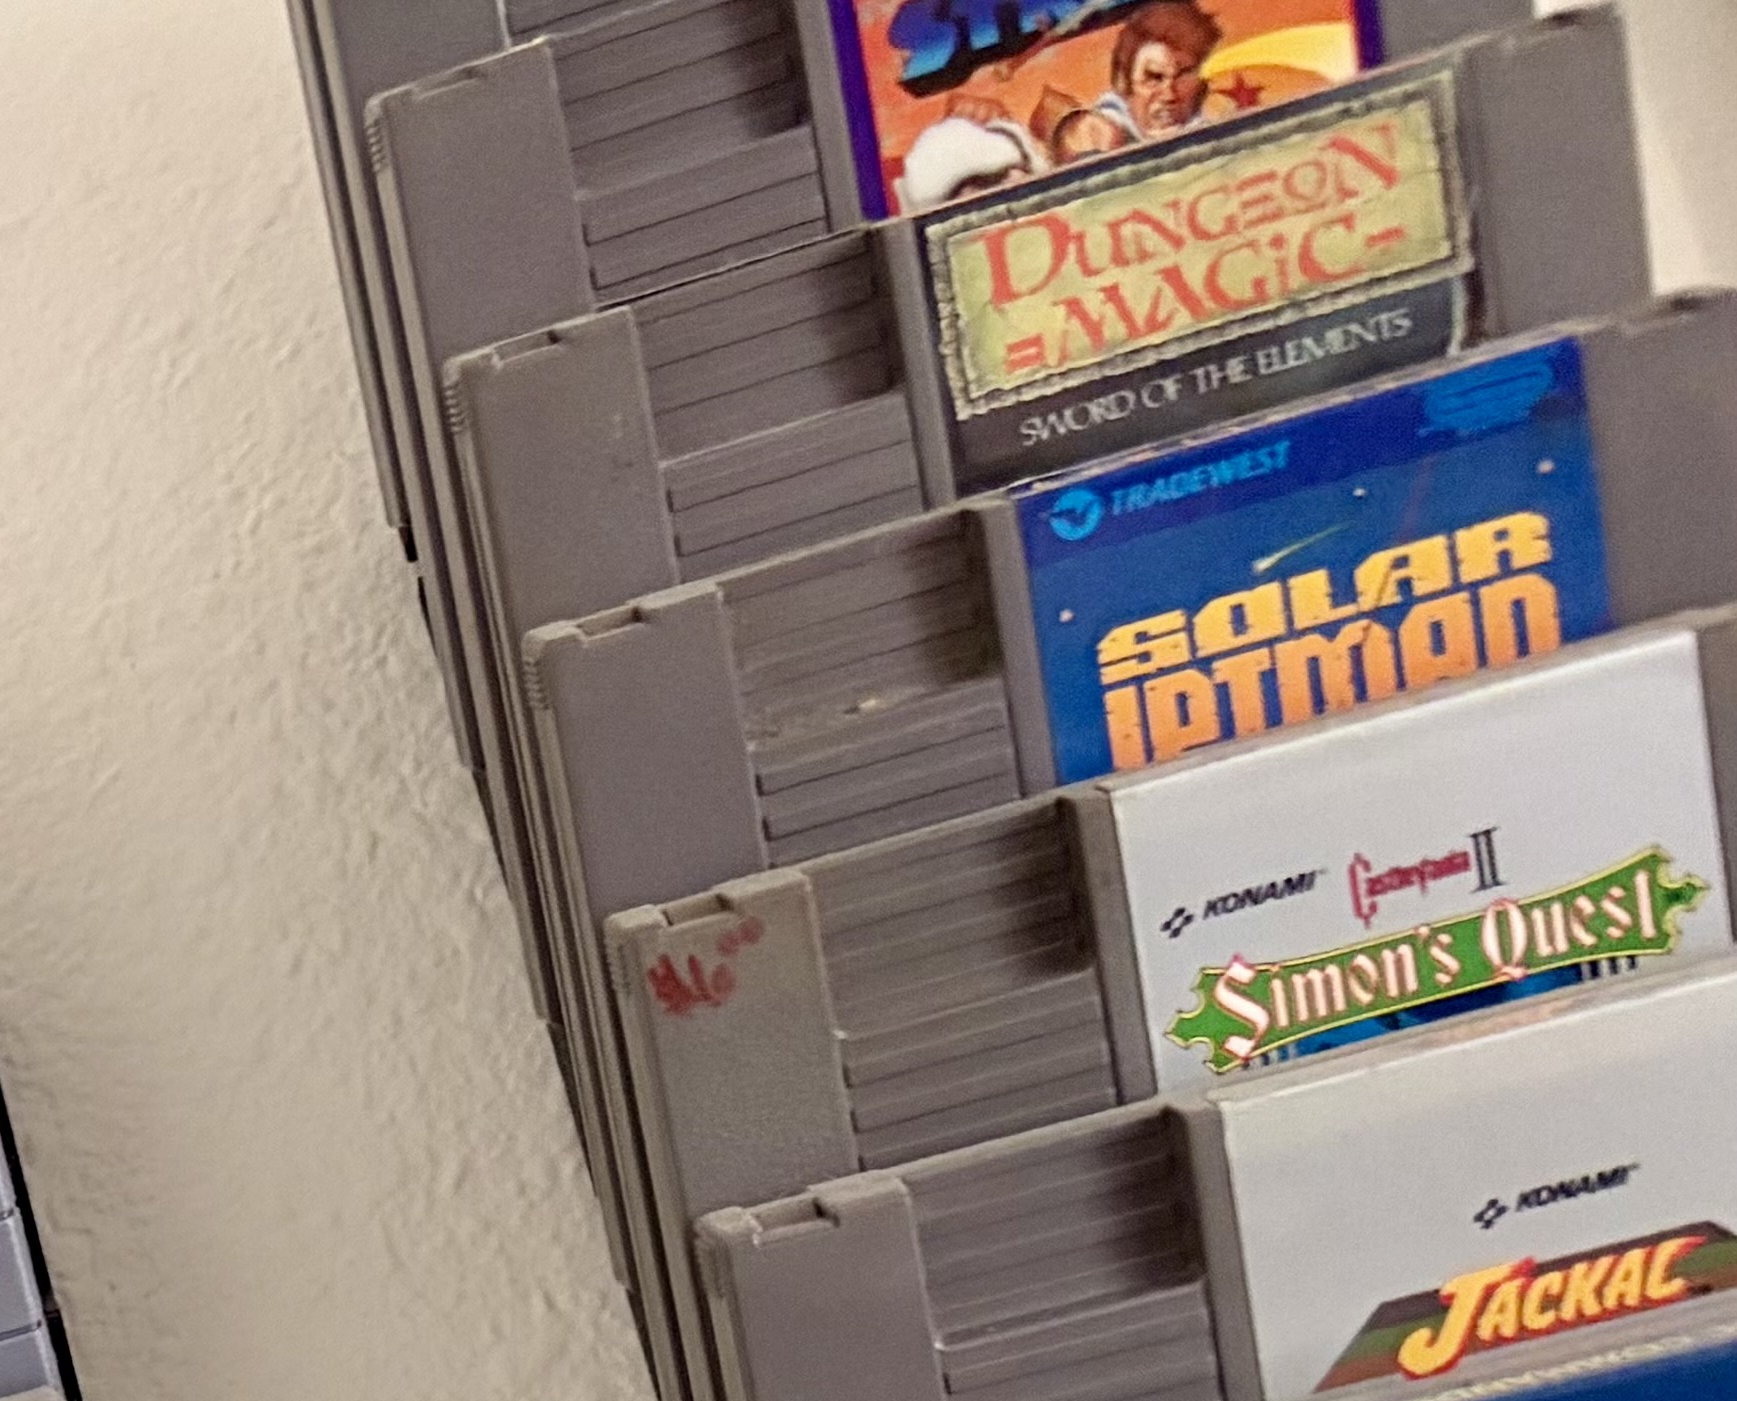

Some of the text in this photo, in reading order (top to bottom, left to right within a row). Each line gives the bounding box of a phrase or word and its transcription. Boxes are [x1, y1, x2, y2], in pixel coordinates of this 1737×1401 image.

[977, 120, 1401, 310] DUNGEON
[1019, 306, 1415, 446] SWORD OF THE ELEMENTS
[1111, 440, 1292, 516] TRADEWEST
[1097, 511, 1553, 685] SOLAR
[1202, 868, 1325, 920] KONAMI
[1213, 868, 1659, 1060] Simon's Quest
[1515, 1162, 1638, 1213] KONAMI
